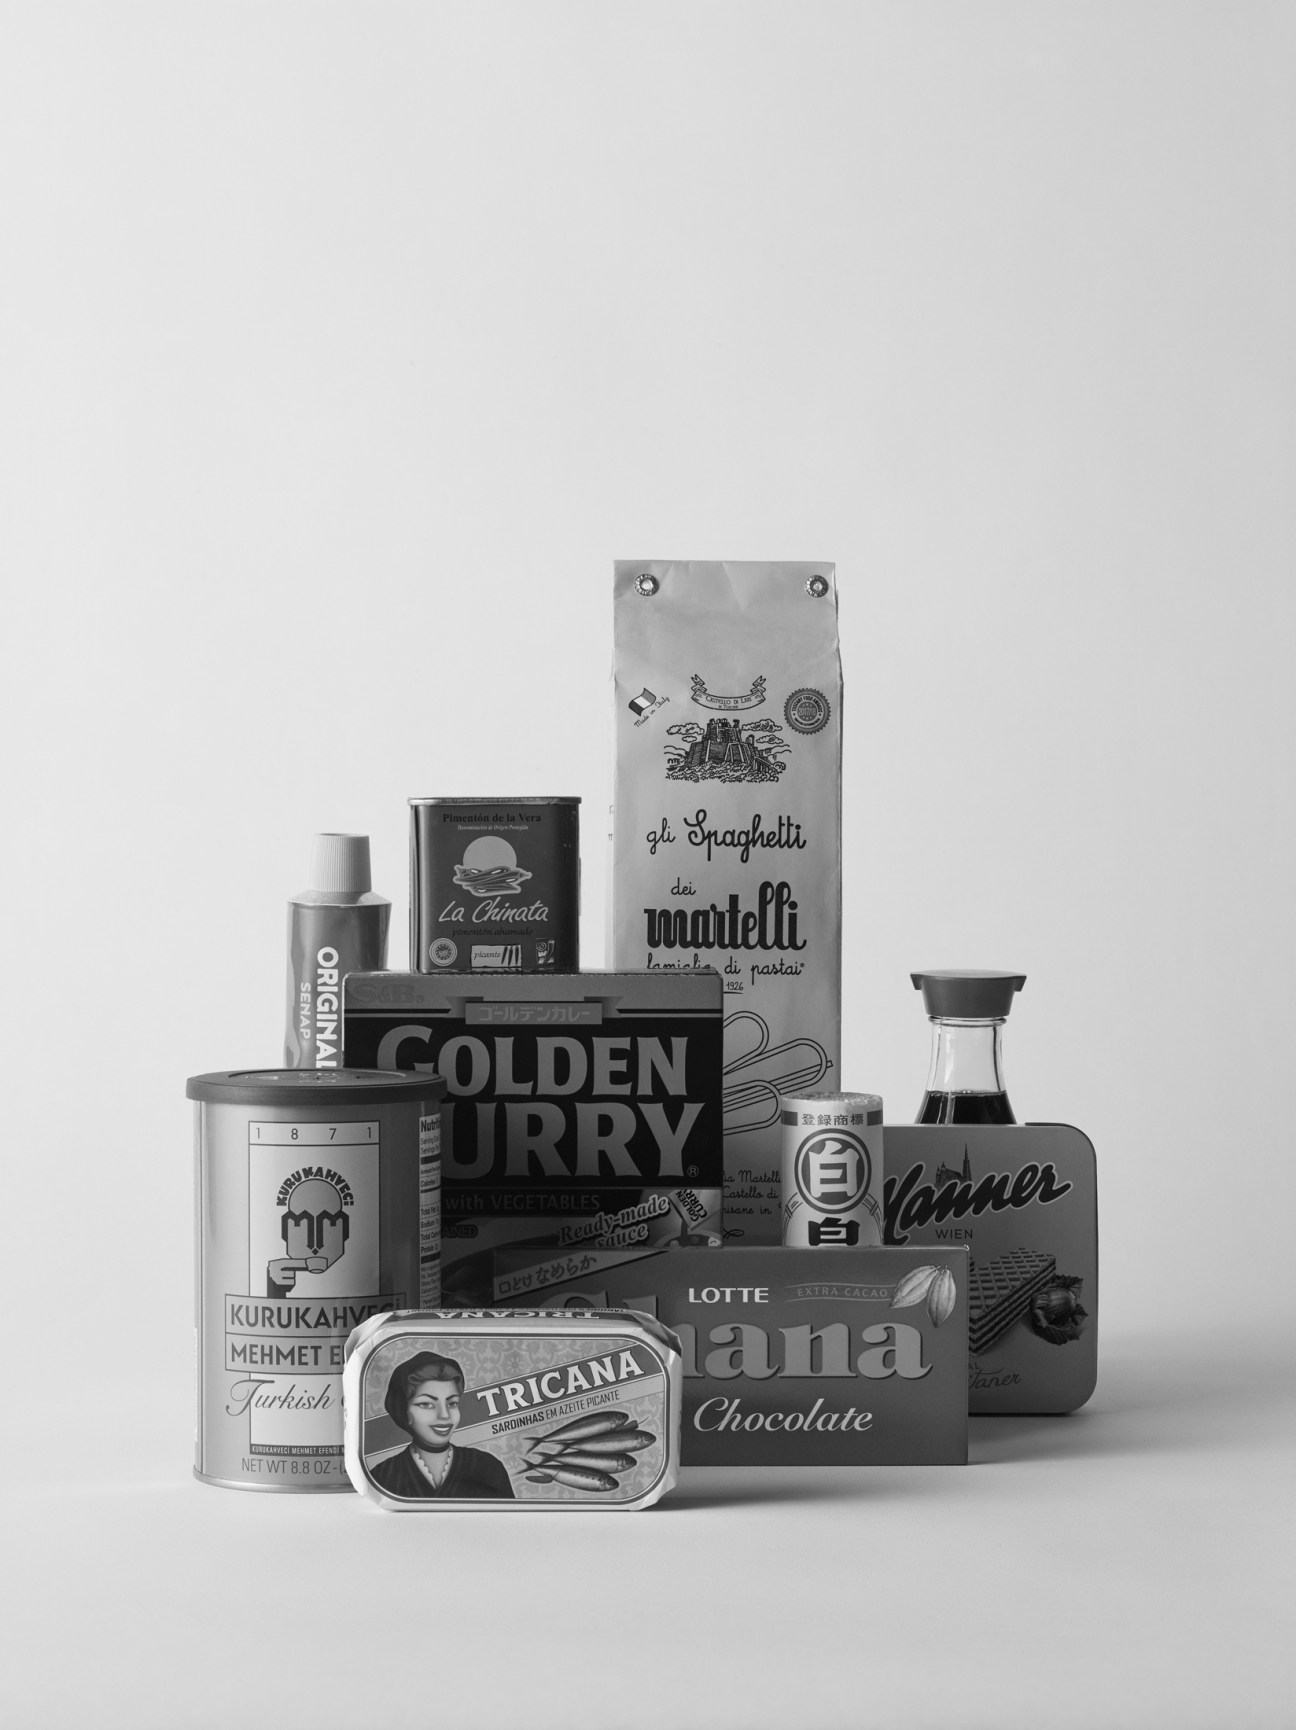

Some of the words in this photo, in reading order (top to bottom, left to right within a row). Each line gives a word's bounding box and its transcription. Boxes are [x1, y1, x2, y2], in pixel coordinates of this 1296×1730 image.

[442, 813, 490, 823] Pimentón
[492, 813, 505, 823] de
[506, 813, 516, 823] la
[518, 813, 542, 823] Vera
[646, 817, 676, 855] gli
[683, 808, 807, 863] Spaghetti
[670, 876, 697, 896] dei
[438, 900, 465, 923] La
[471, 896, 549, 923] Chinata
[643, 880, 808, 951] martelli
[451, 927, 493, 939] pimentón
[494, 926, 534, 936] ahumado
[474, 951, 502, 961] picante
[723, 955, 741, 975] di
[725, 981, 744, 991] 1926
[300, 982, 312, 1040] SENAP
[315, 946, 339, 1069] ORIGINAL
[479, 1006, 591, 1022] ゴールデンカレー
[376, 1024, 689, 1097] GOLDEN
[801, 1113, 864, 1126] 登録商標
[440, 1101, 707, 1180] URRY
[738, 1169, 782, 1183] Martelli
[445, 1194, 484, 1210] with
[490, 1194, 601, 1210] VEGETABLES
[722, 1185, 764, 1199] Castello
[767, 1186, 779, 1199] di
[675, 1190, 700, 1222] GOLDEN
[441, 1224, 478, 1238] AINED
[558, 1194, 669, 1246] Ready-made
[595, 1224, 649, 1248] sauce
[935, 1228, 973, 1240] WIEN
[688, 1287, 769, 1304] LOTTE
[797, 1287, 838, 1298] EXTRA
[844, 1287, 889, 1299] CACAO
[612, 1292, 934, 1381] hana
[231, 1342, 323, 1366] MEHMET
[476, 1350, 645, 1418] TRICANA
[968, 1367, 1022, 1390] taner
[225, 1378, 337, 1417] Turkish
[491, 1411, 545, 1435] SARDINHAS
[545, 1409, 558, 1420] EM
[558, 1400, 585, 1416] AZEITE
[586, 1390, 620, 1409] PICANTE
[692, 1396, 874, 1433] Chocolate
[291, 1447, 317, 1455] MEHMET
[241, 1457, 263, 1472] NET
[266, 1459, 287, 1474] WT
[290, 1460, 310, 1475] 8.8
